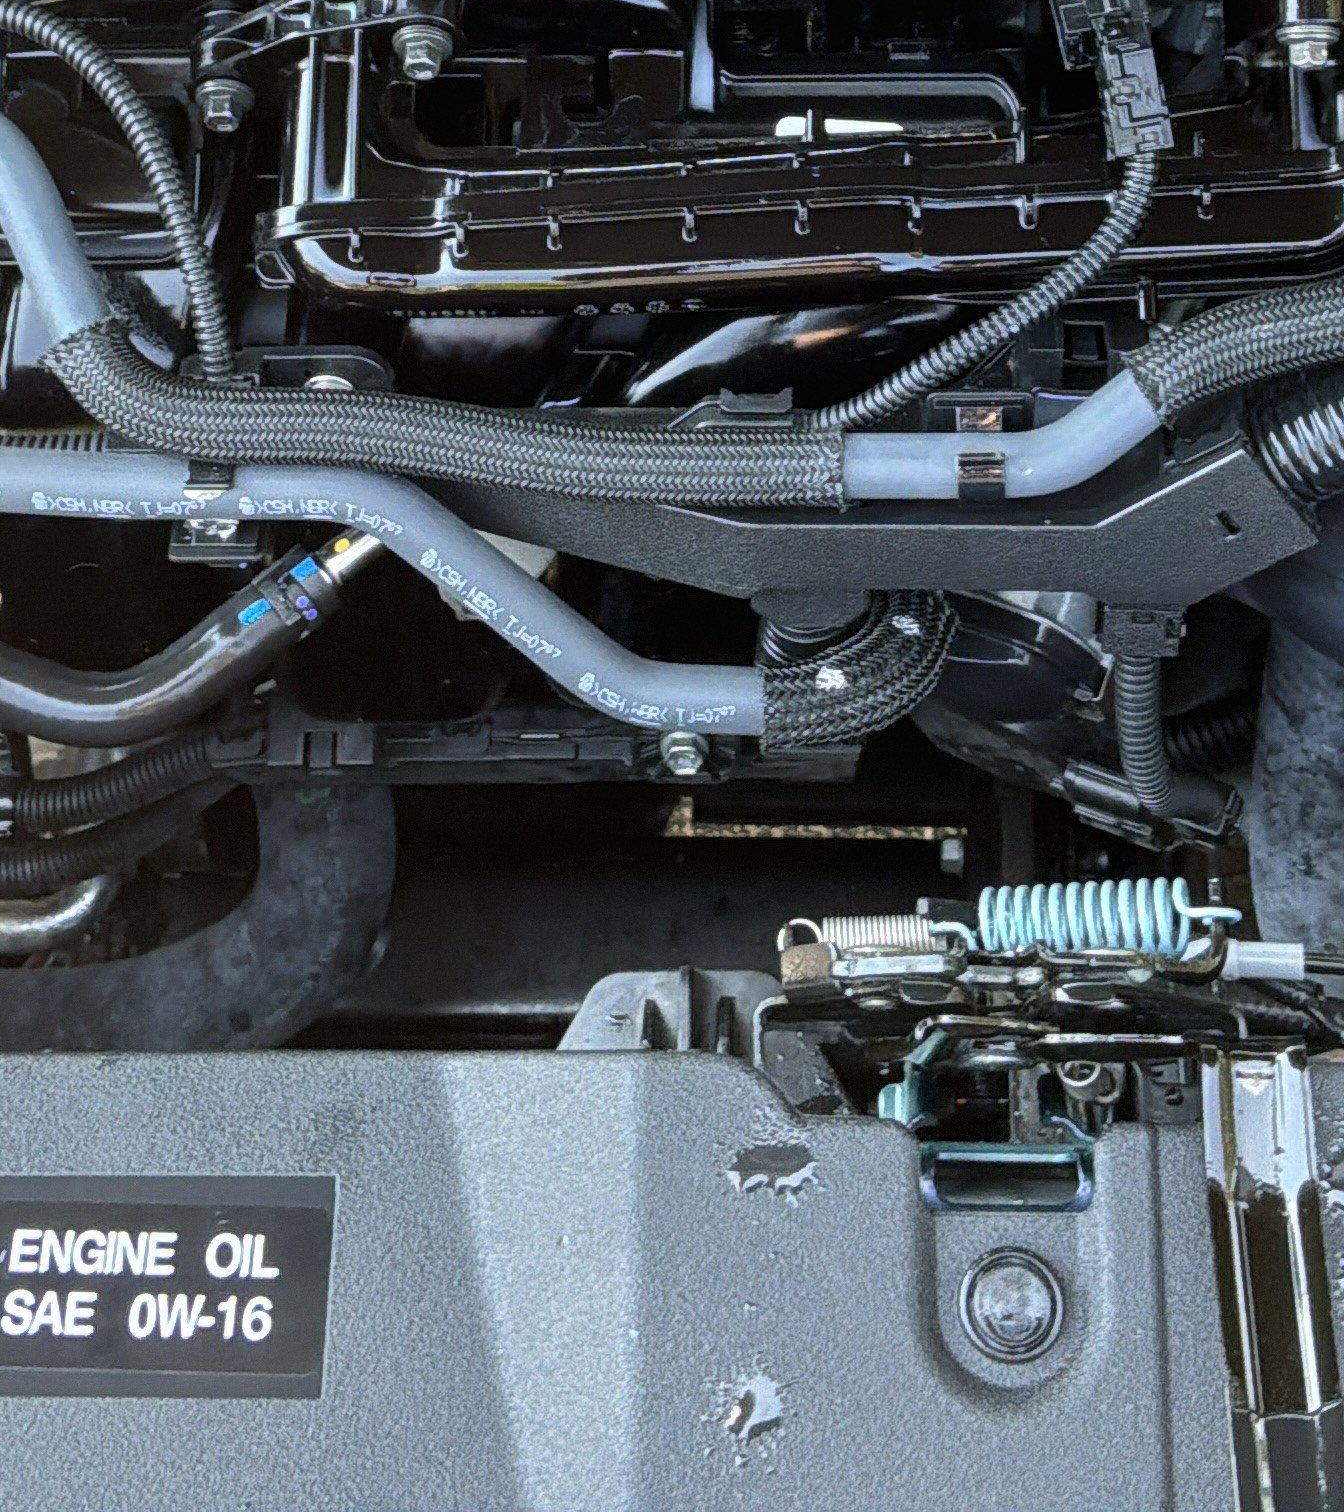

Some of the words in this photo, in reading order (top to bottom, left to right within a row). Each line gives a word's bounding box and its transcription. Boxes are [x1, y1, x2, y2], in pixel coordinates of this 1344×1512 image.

[7, 1228, 179, 1279] ENGINE
[203, 1232, 281, 1281] OIL
[0, 1287, 98, 1338] SAE
[127, 1293, 274, 1343] 0W-16
